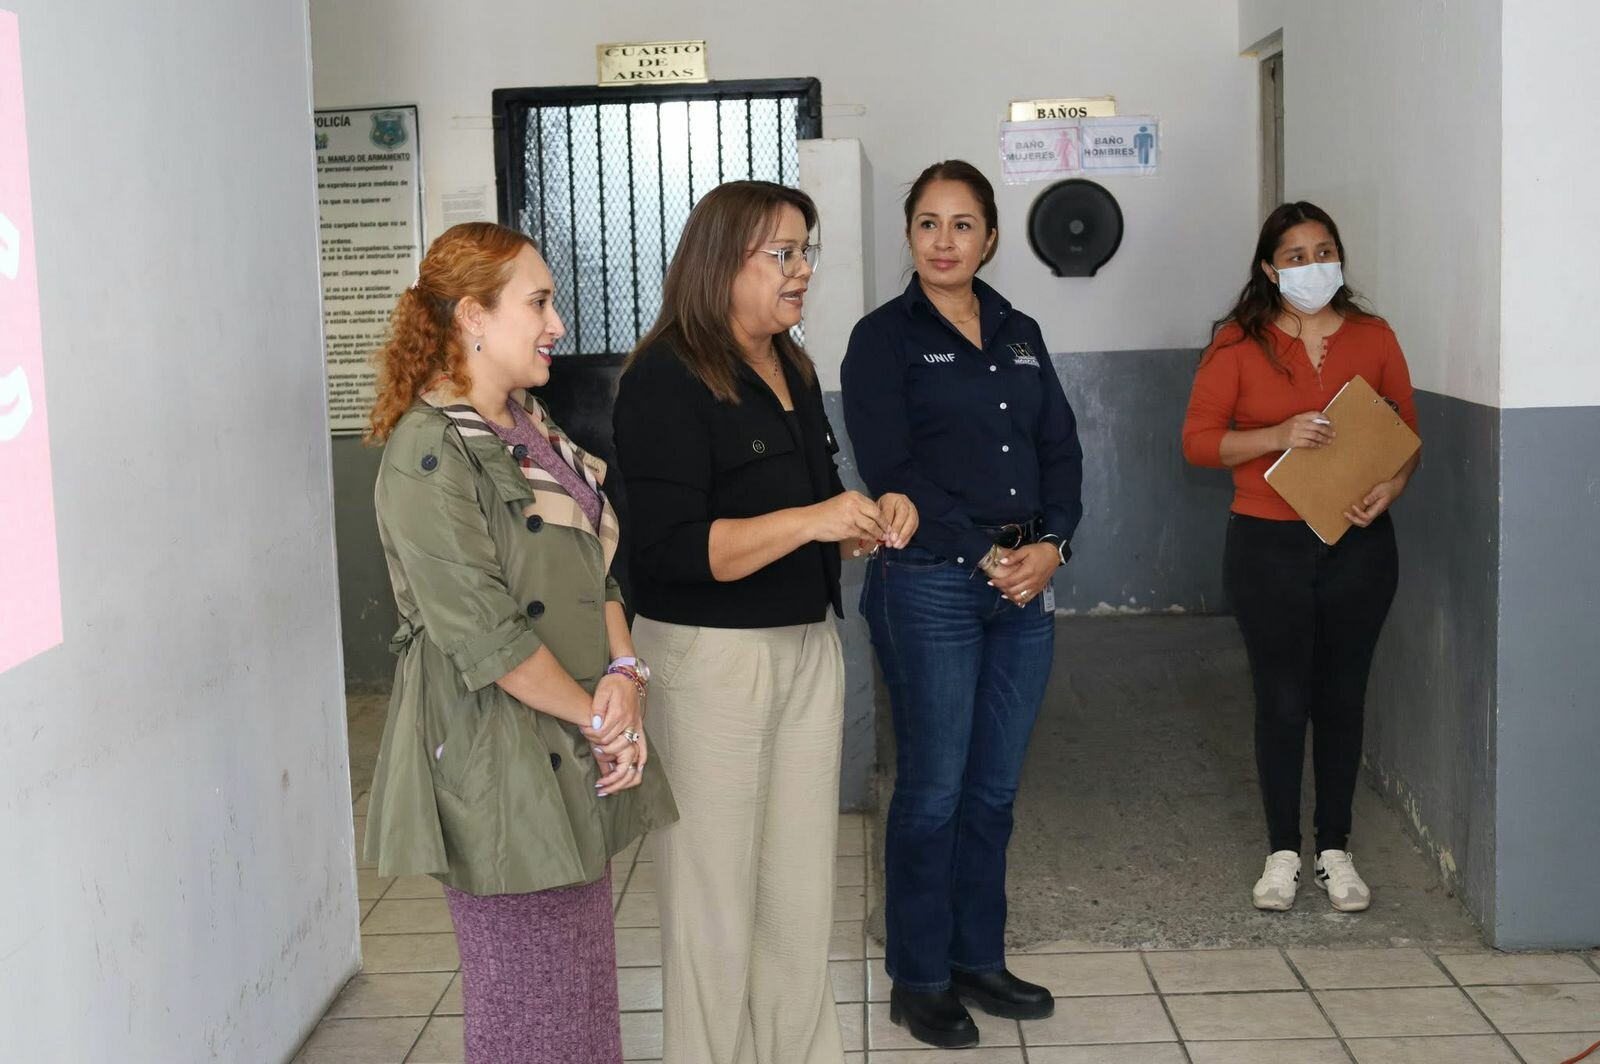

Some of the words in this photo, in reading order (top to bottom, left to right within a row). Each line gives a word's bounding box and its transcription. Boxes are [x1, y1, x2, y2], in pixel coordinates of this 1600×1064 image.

[605, 45, 700, 57] CUARTO
[638, 58, 668, 67] DE
[613, 68, 694, 80] ARMAS
[1037, 105, 1088, 119] BAÑOS
[1015, 140, 1045, 150] BAÑO
[1094, 136, 1124, 145] BAÑO
[357, 154, 367, 162] DE
[367, 152, 411, 161] ARMAMENTO
[1006, 151, 1056, 161] MUJERES
[1084, 148, 1135, 157] HOMBRES
[923, 353, 956, 363] UNIF
